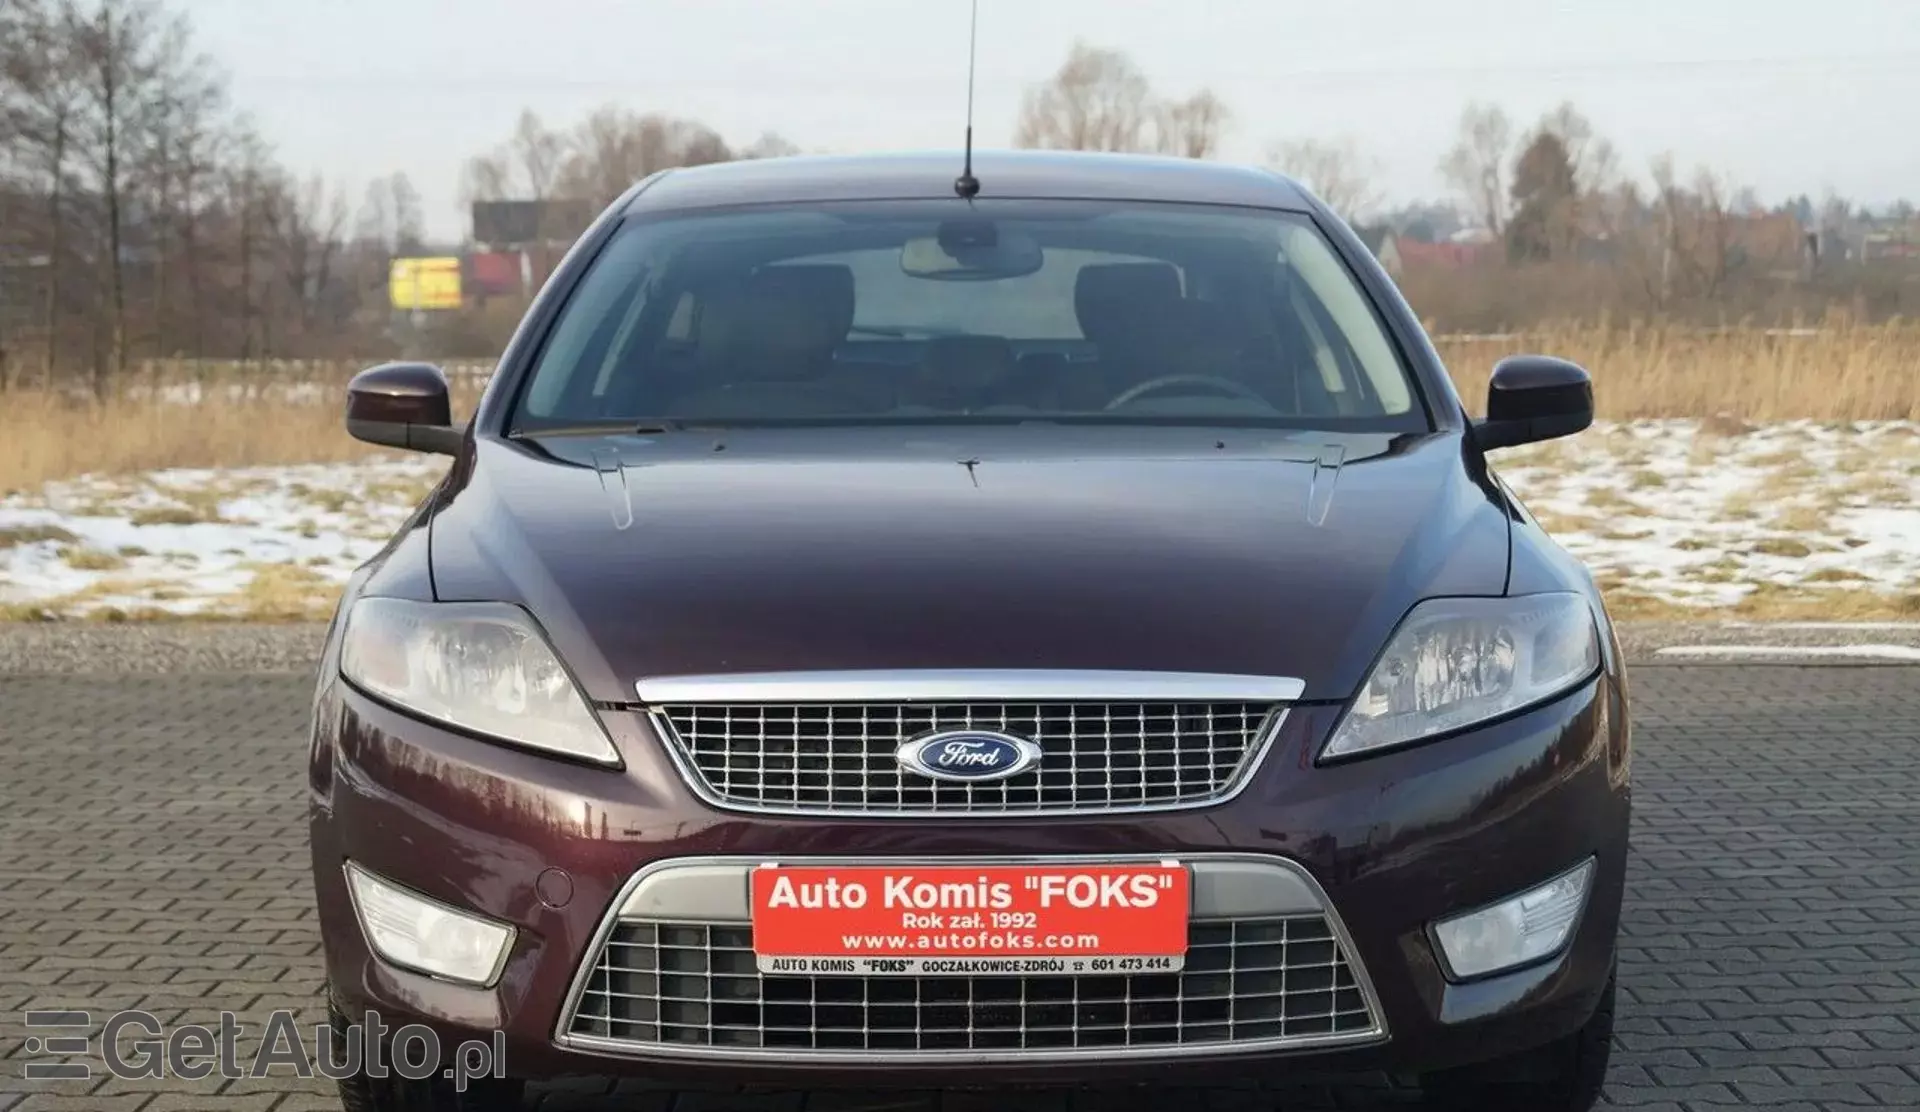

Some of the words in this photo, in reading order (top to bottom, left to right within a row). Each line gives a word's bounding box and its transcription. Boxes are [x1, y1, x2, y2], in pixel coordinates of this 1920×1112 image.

[938, 741, 1001, 767] Ford
[768, 875, 868, 909] Auto
[884, 875, 1013, 909] Komis
[1024, 874, 1173, 909] "FOKS"
[902, 912, 944, 930] Rok
[949, 912, 985, 929] zał.
[990, 912, 1038, 929] 1992
[842, 931, 1100, 949] www.autofoks.com
[772, 958, 808, 972] AUTO
[811, 958, 856, 972] KOMIS
[922, 958, 1066, 973] GOCZAŁKOWICE-ZDRÓJ
[1091, 958, 1115, 971] 601
[1119, 958, 1143, 970] 473
[1146, 957, 1171, 970] 414
